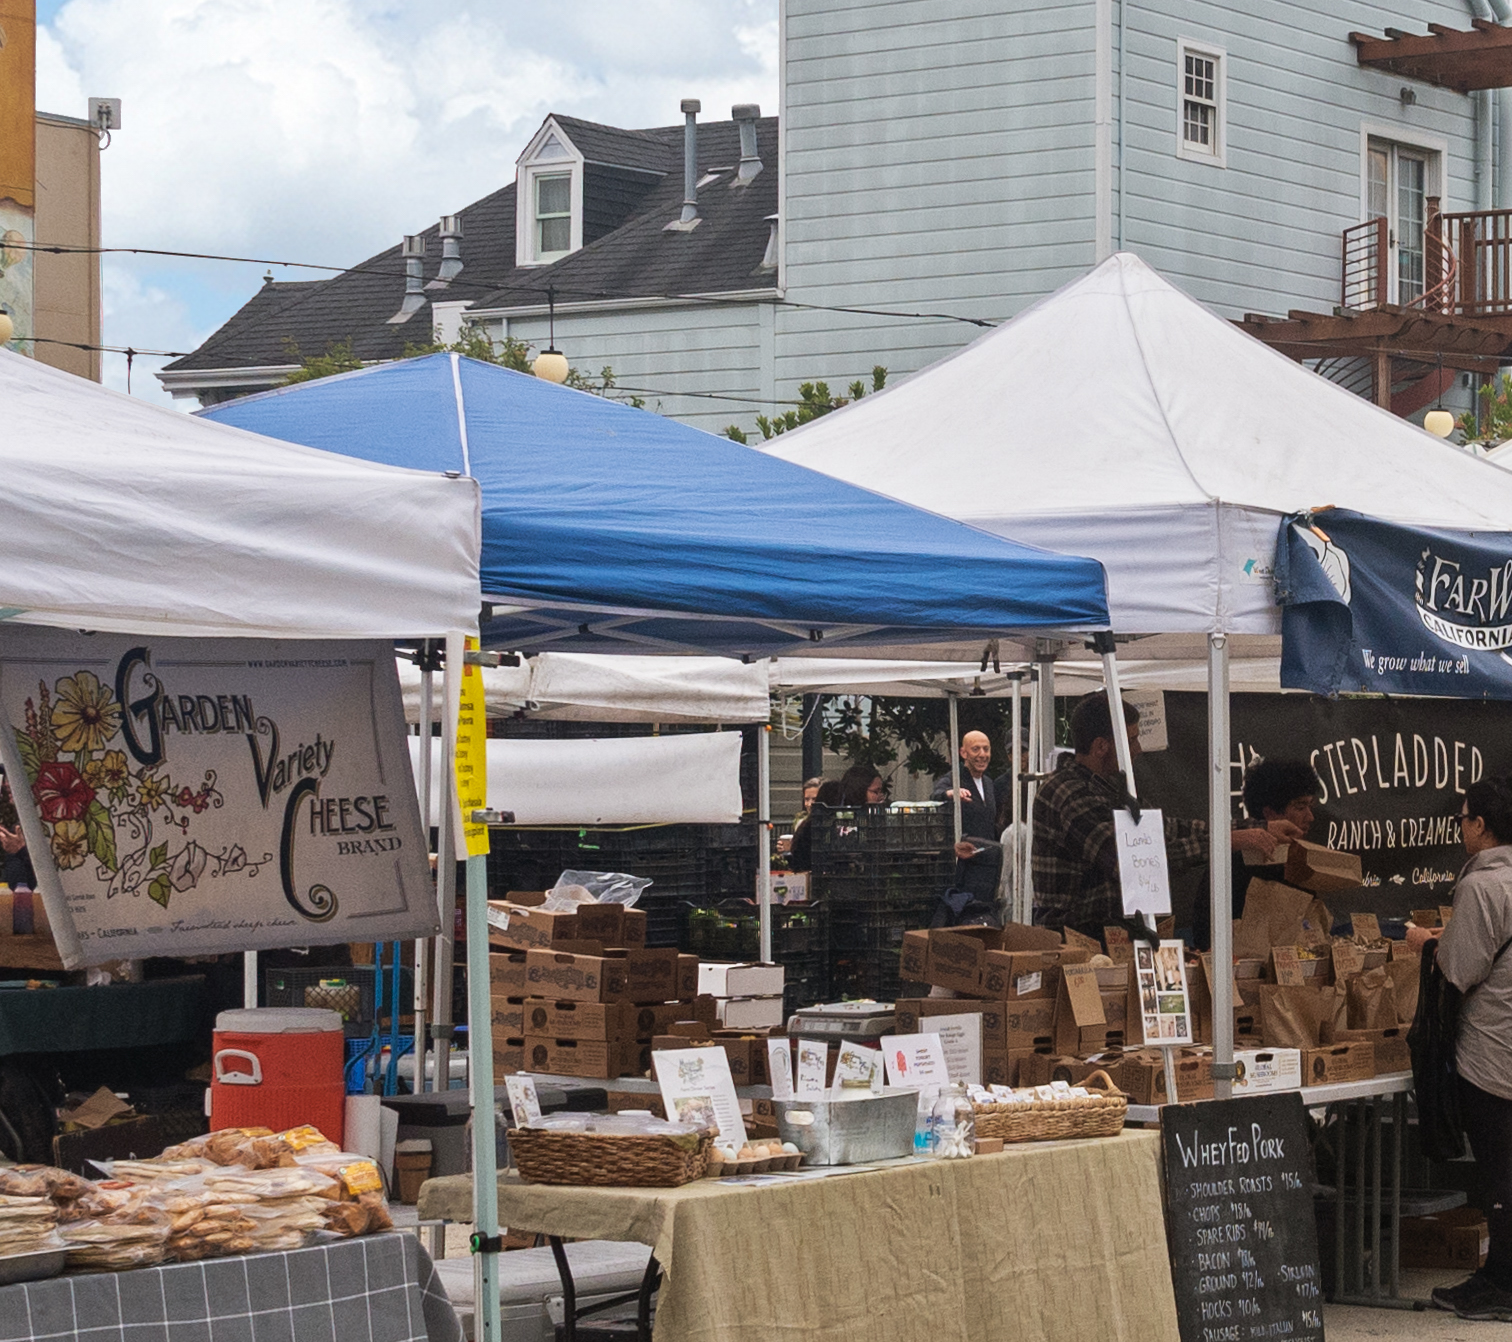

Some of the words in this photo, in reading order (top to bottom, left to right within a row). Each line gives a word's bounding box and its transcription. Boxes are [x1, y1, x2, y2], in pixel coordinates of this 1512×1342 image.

[1361, 648, 1376, 670] We
[1377, 655, 1407, 676] grow
[1409, 651, 1437, 674] what
[1438, 658, 1454, 674] we
[1454, 654, 1470, 675] sell
[115, 646, 257, 767] GARDEN
[245, 715, 336, 810] Variety
[1124, 832, 1152, 848] Lamb
[1327, 819, 1381, 851] RANCH
[1386, 818, 1396, 849] &
[1400, 816, 1462, 848] CREAMER
[279, 776, 396, 923] CHEESE
[336, 836, 402, 865] BRAND
[1411, 867, 1456, 891] California
[1251, 1122, 1285, 1162] PORK
[1190, 1179, 1235, 1199] SHOULDER
[1239, 1176, 1273, 1194] ROASTS
[1192, 1205, 1221, 1222] CHOPS
[1198, 1252, 1231, 1272] BACON
[1199, 1273, 1238, 1294] GROUND
[1201, 1299, 1233, 1322] HOCKS
